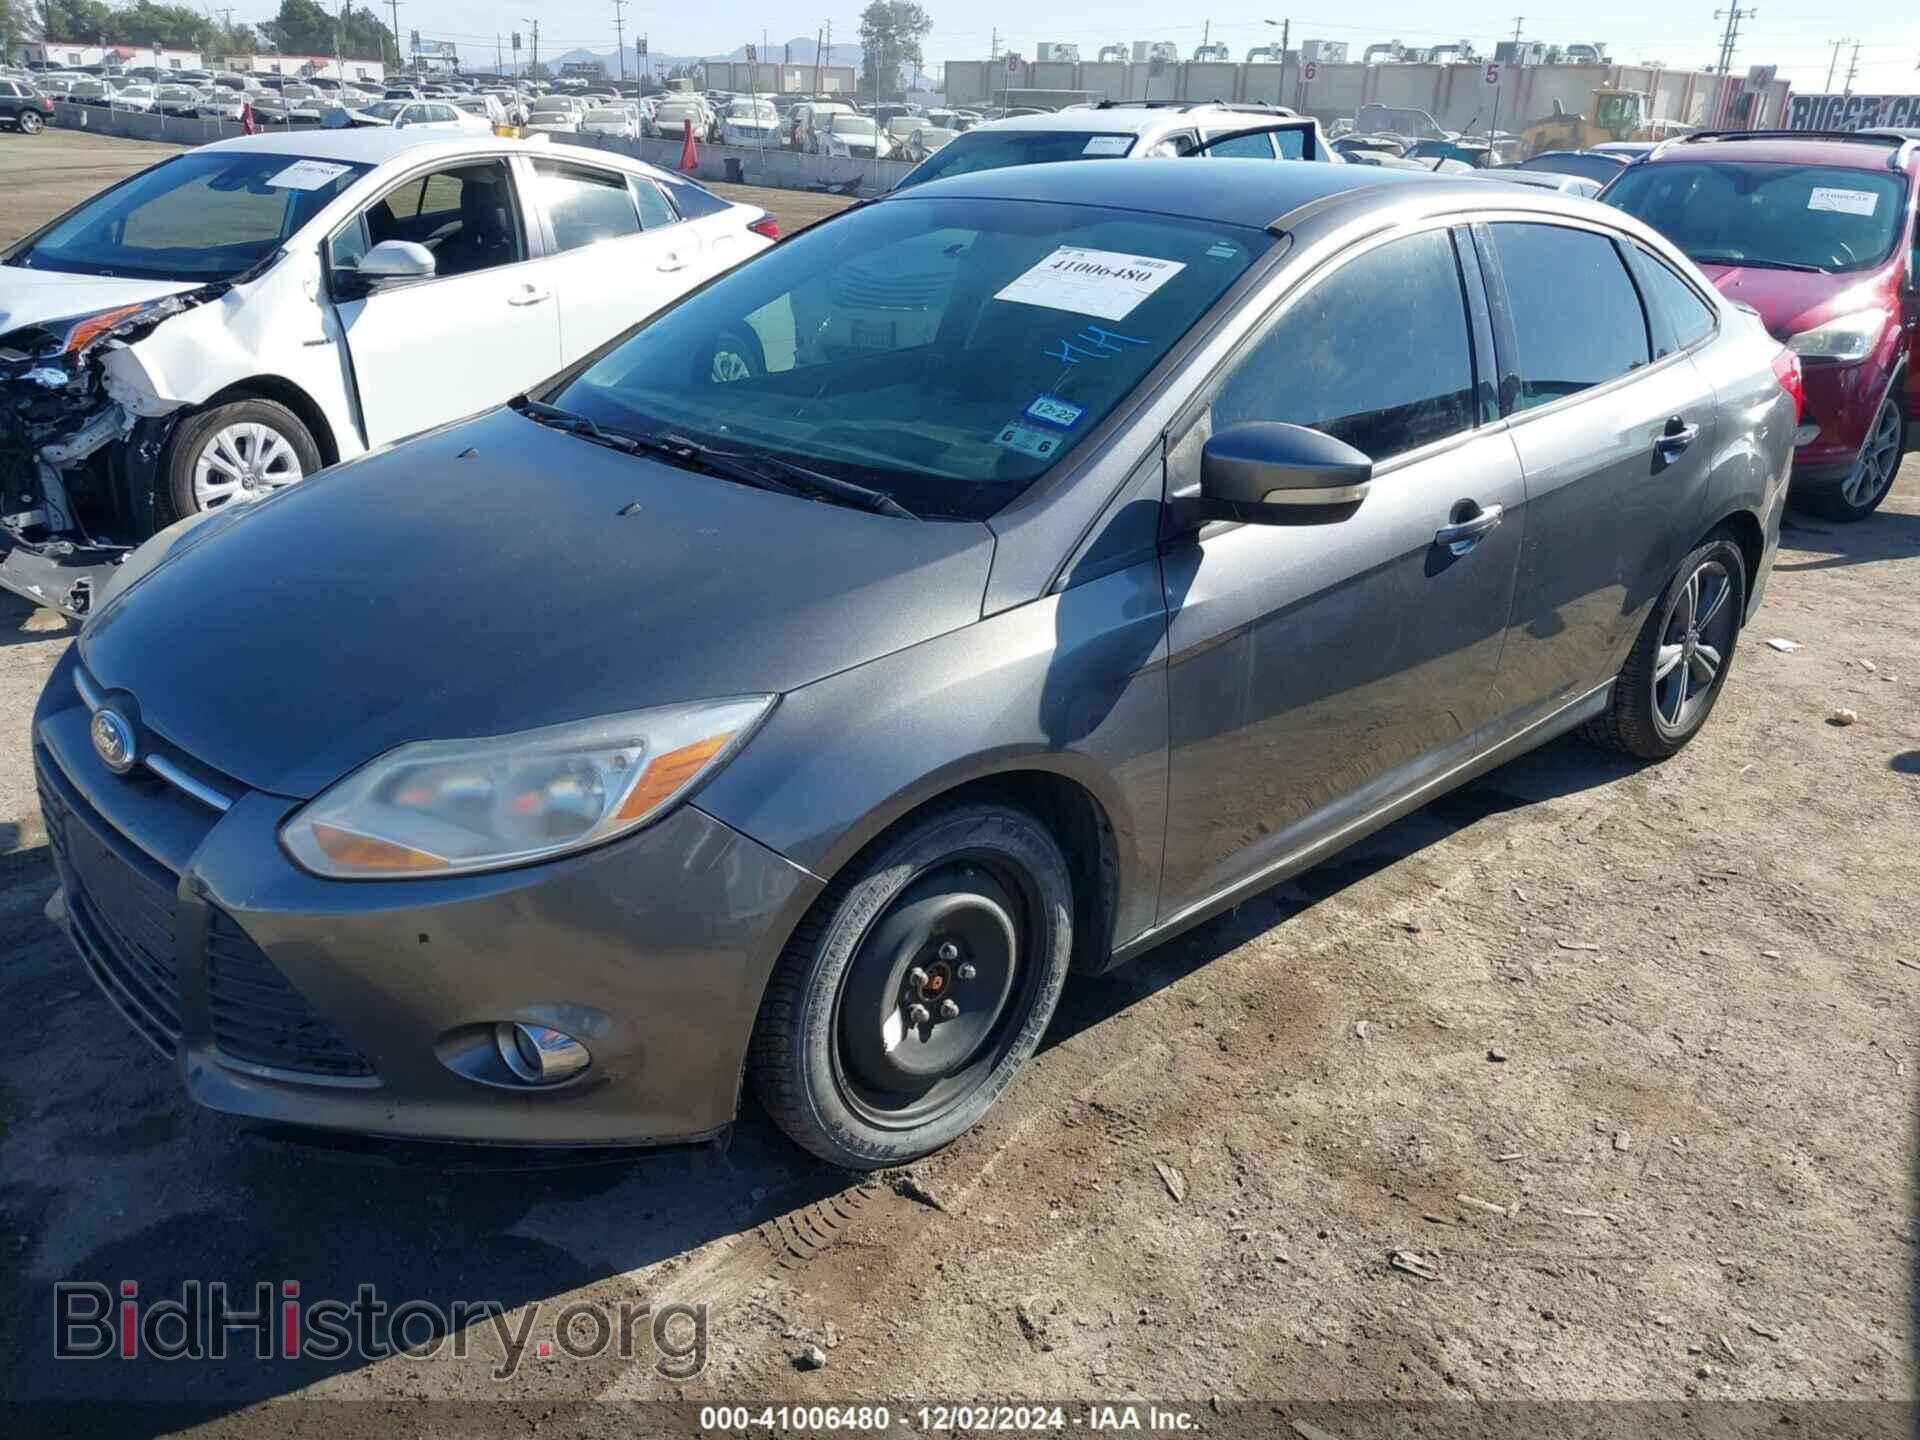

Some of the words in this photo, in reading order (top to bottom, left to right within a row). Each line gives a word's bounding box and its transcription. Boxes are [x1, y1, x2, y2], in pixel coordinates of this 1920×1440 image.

[1008, 55, 1017, 72] 8
[1305, 61, 1316, 80] 6
[1486, 64, 1499, 84] 5
[1051, 260, 1152, 282] 41006480
